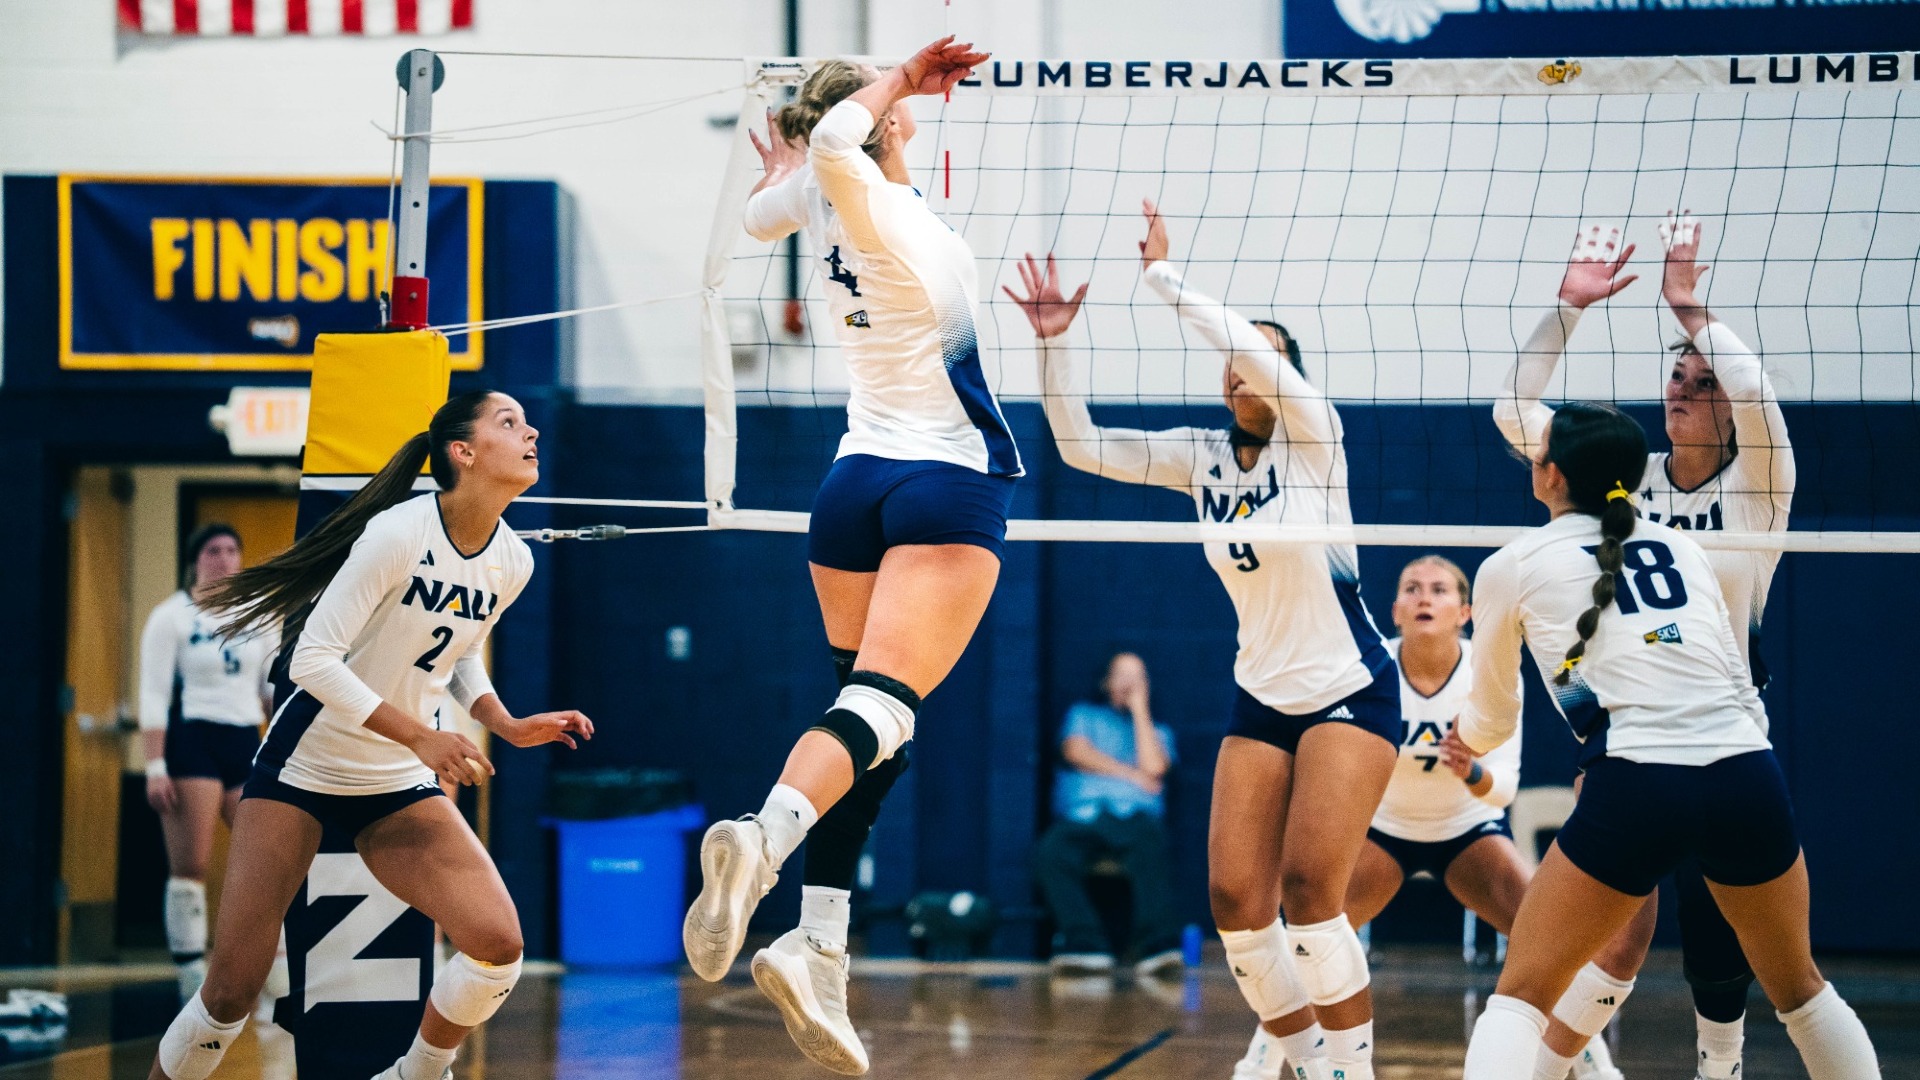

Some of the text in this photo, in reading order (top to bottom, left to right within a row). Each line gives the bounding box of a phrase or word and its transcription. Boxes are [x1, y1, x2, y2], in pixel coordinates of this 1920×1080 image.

[1730, 53, 1920, 84] LUMB
[151, 217, 396, 301] FINISH
[1203, 464, 1279, 523] NAU
[401, 576, 498, 621] NAU
[1580, 540, 1688, 615] 18
[414, 626, 453, 673] 2
[1656, 624, 1680, 640] SKY
